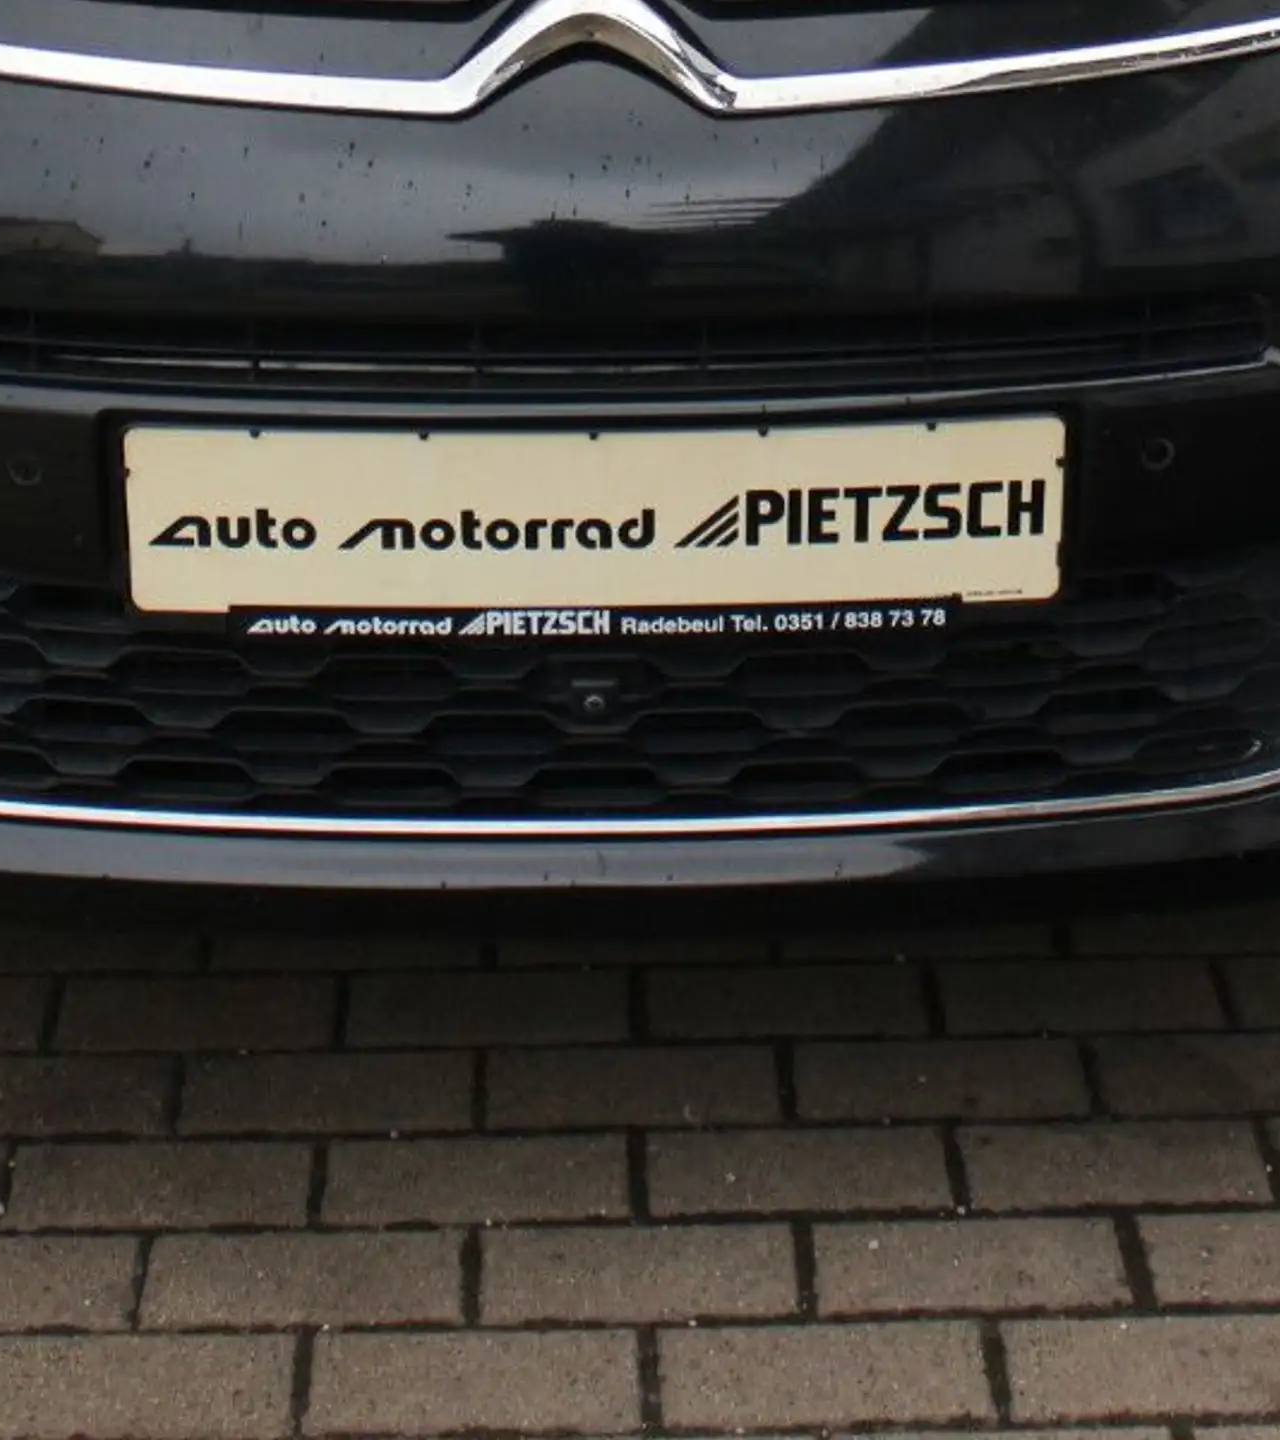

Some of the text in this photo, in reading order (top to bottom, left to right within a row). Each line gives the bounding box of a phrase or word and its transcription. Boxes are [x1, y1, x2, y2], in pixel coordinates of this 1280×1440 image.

[337, 508, 656, 551] motorrad
[745, 478, 1046, 547] PIETZSCH
[323, 616, 453, 636] motorrad
[486, 610, 611, 636] PIETZSCH
[621, 615, 724, 635] Radebeul
[730, 613, 769, 634] Tel.
[774, 611, 824, 632] 0351
[830, 611, 839, 631] /
[844, 610, 883, 630] 838
[889, 609, 915, 629] 73
[921, 608, 947, 627] 78
